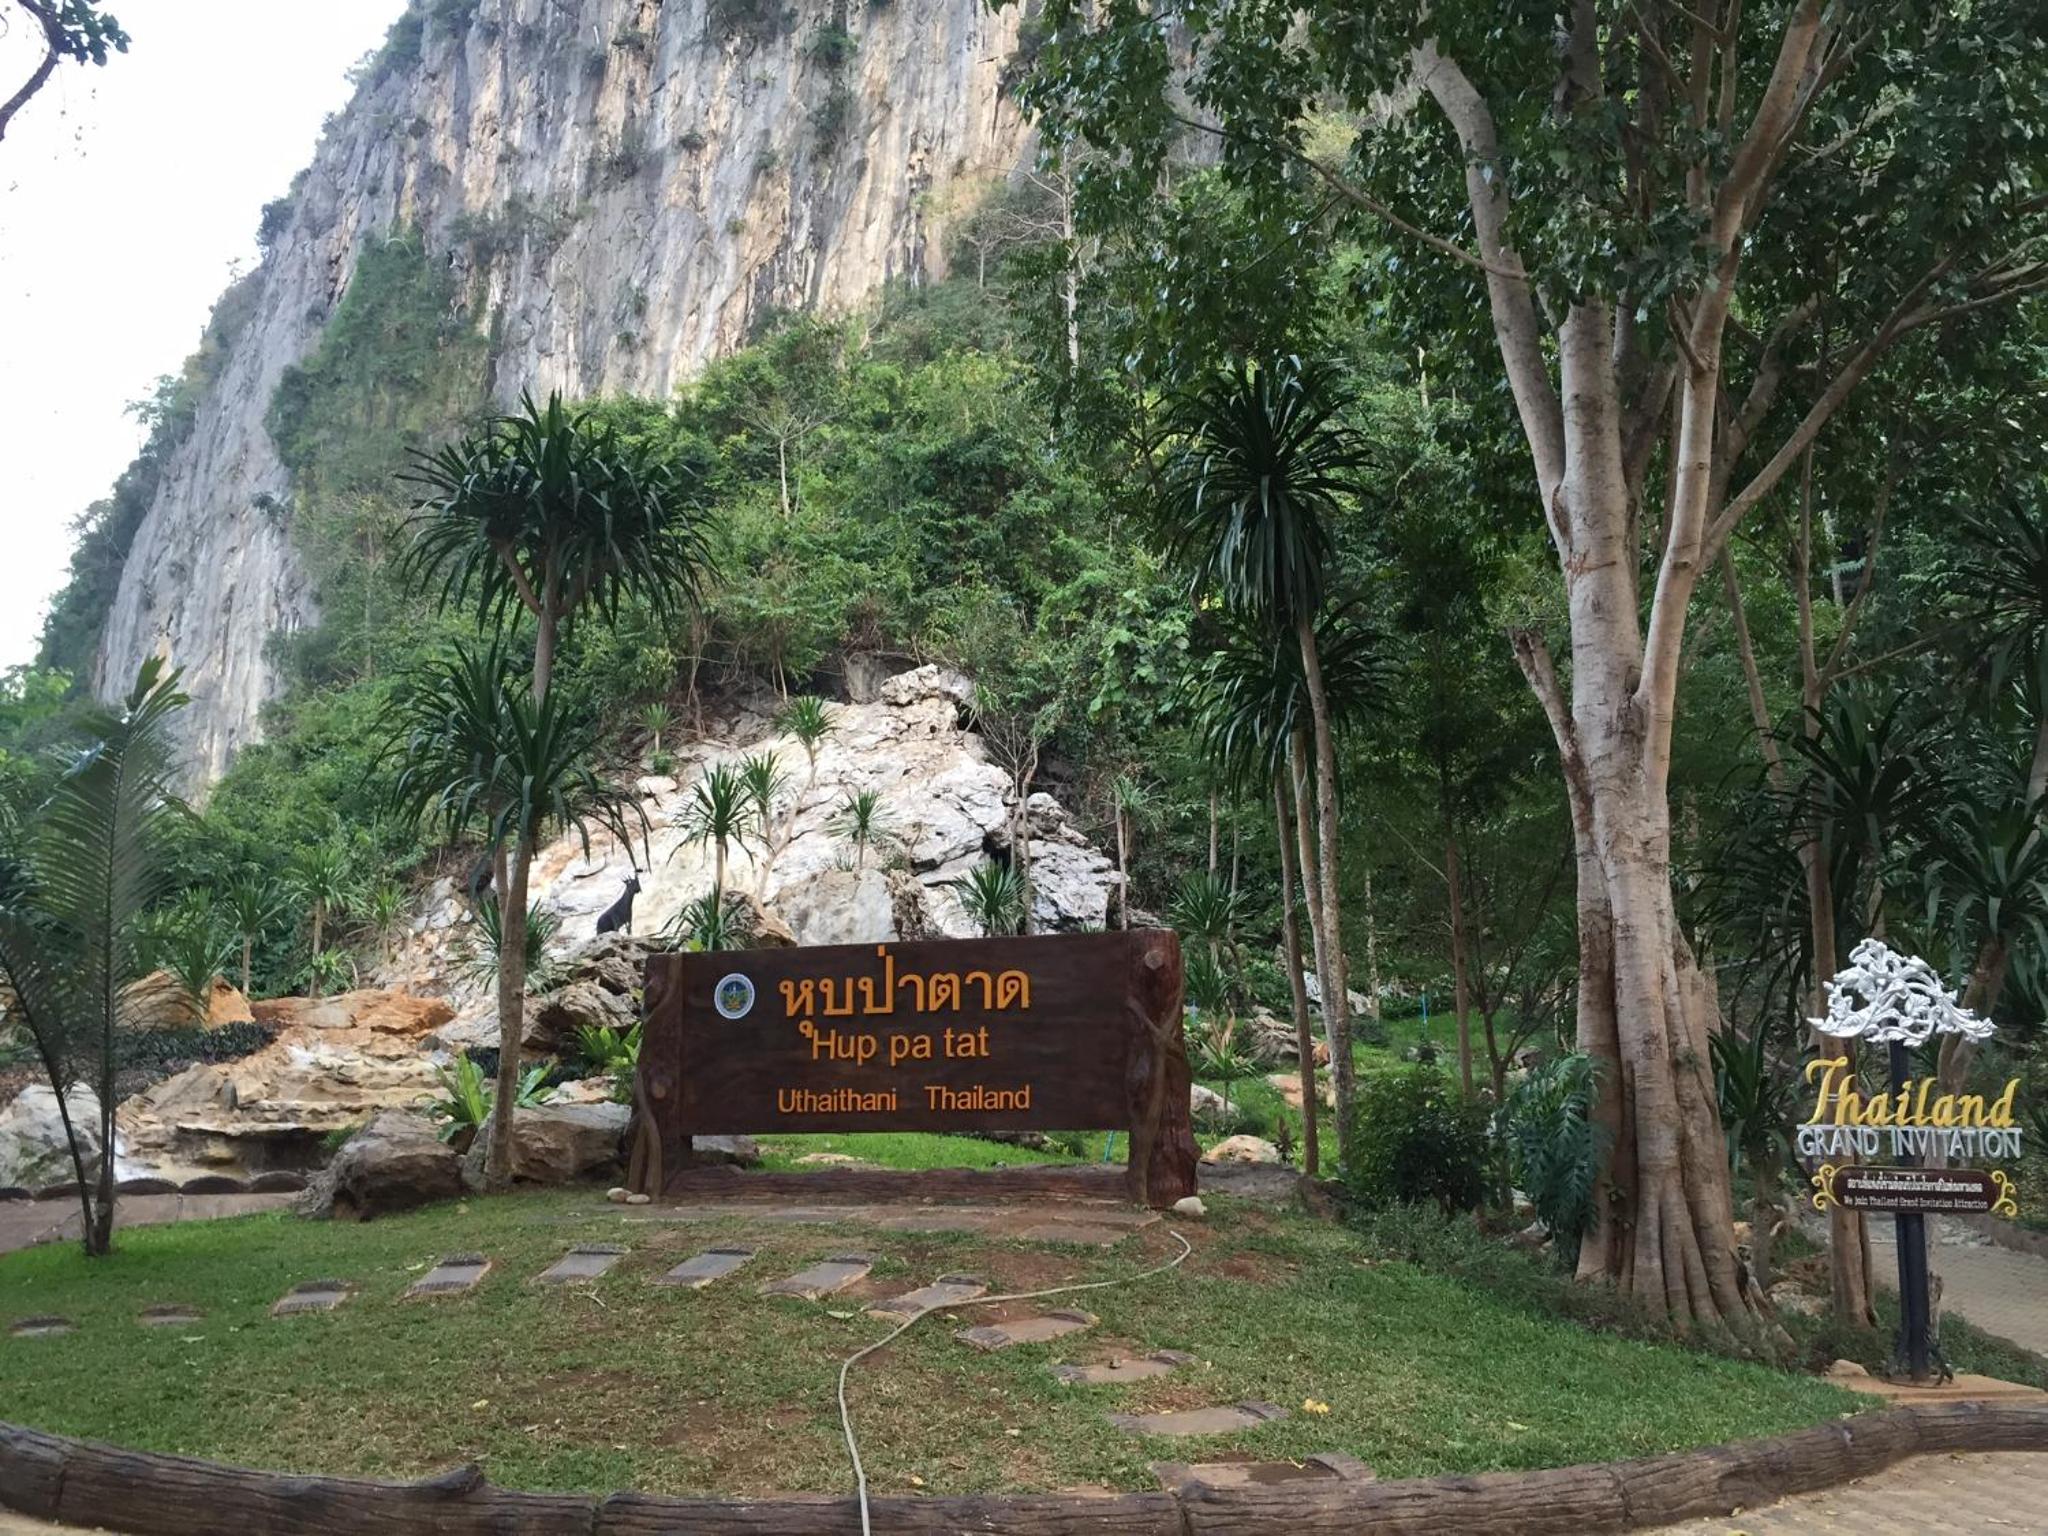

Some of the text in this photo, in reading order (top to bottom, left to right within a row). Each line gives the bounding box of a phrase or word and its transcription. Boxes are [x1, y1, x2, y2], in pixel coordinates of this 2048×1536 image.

[779, 945, 1030, 1037] หุบป่าตาด
[812, 1026, 990, 1066] Hup pa tat
[778, 1084, 1030, 1113] Uthaithani Thailand
[1805, 1056, 2021, 1128] Thailand
[1797, 1127, 2022, 1159] GRAND INVITATION
